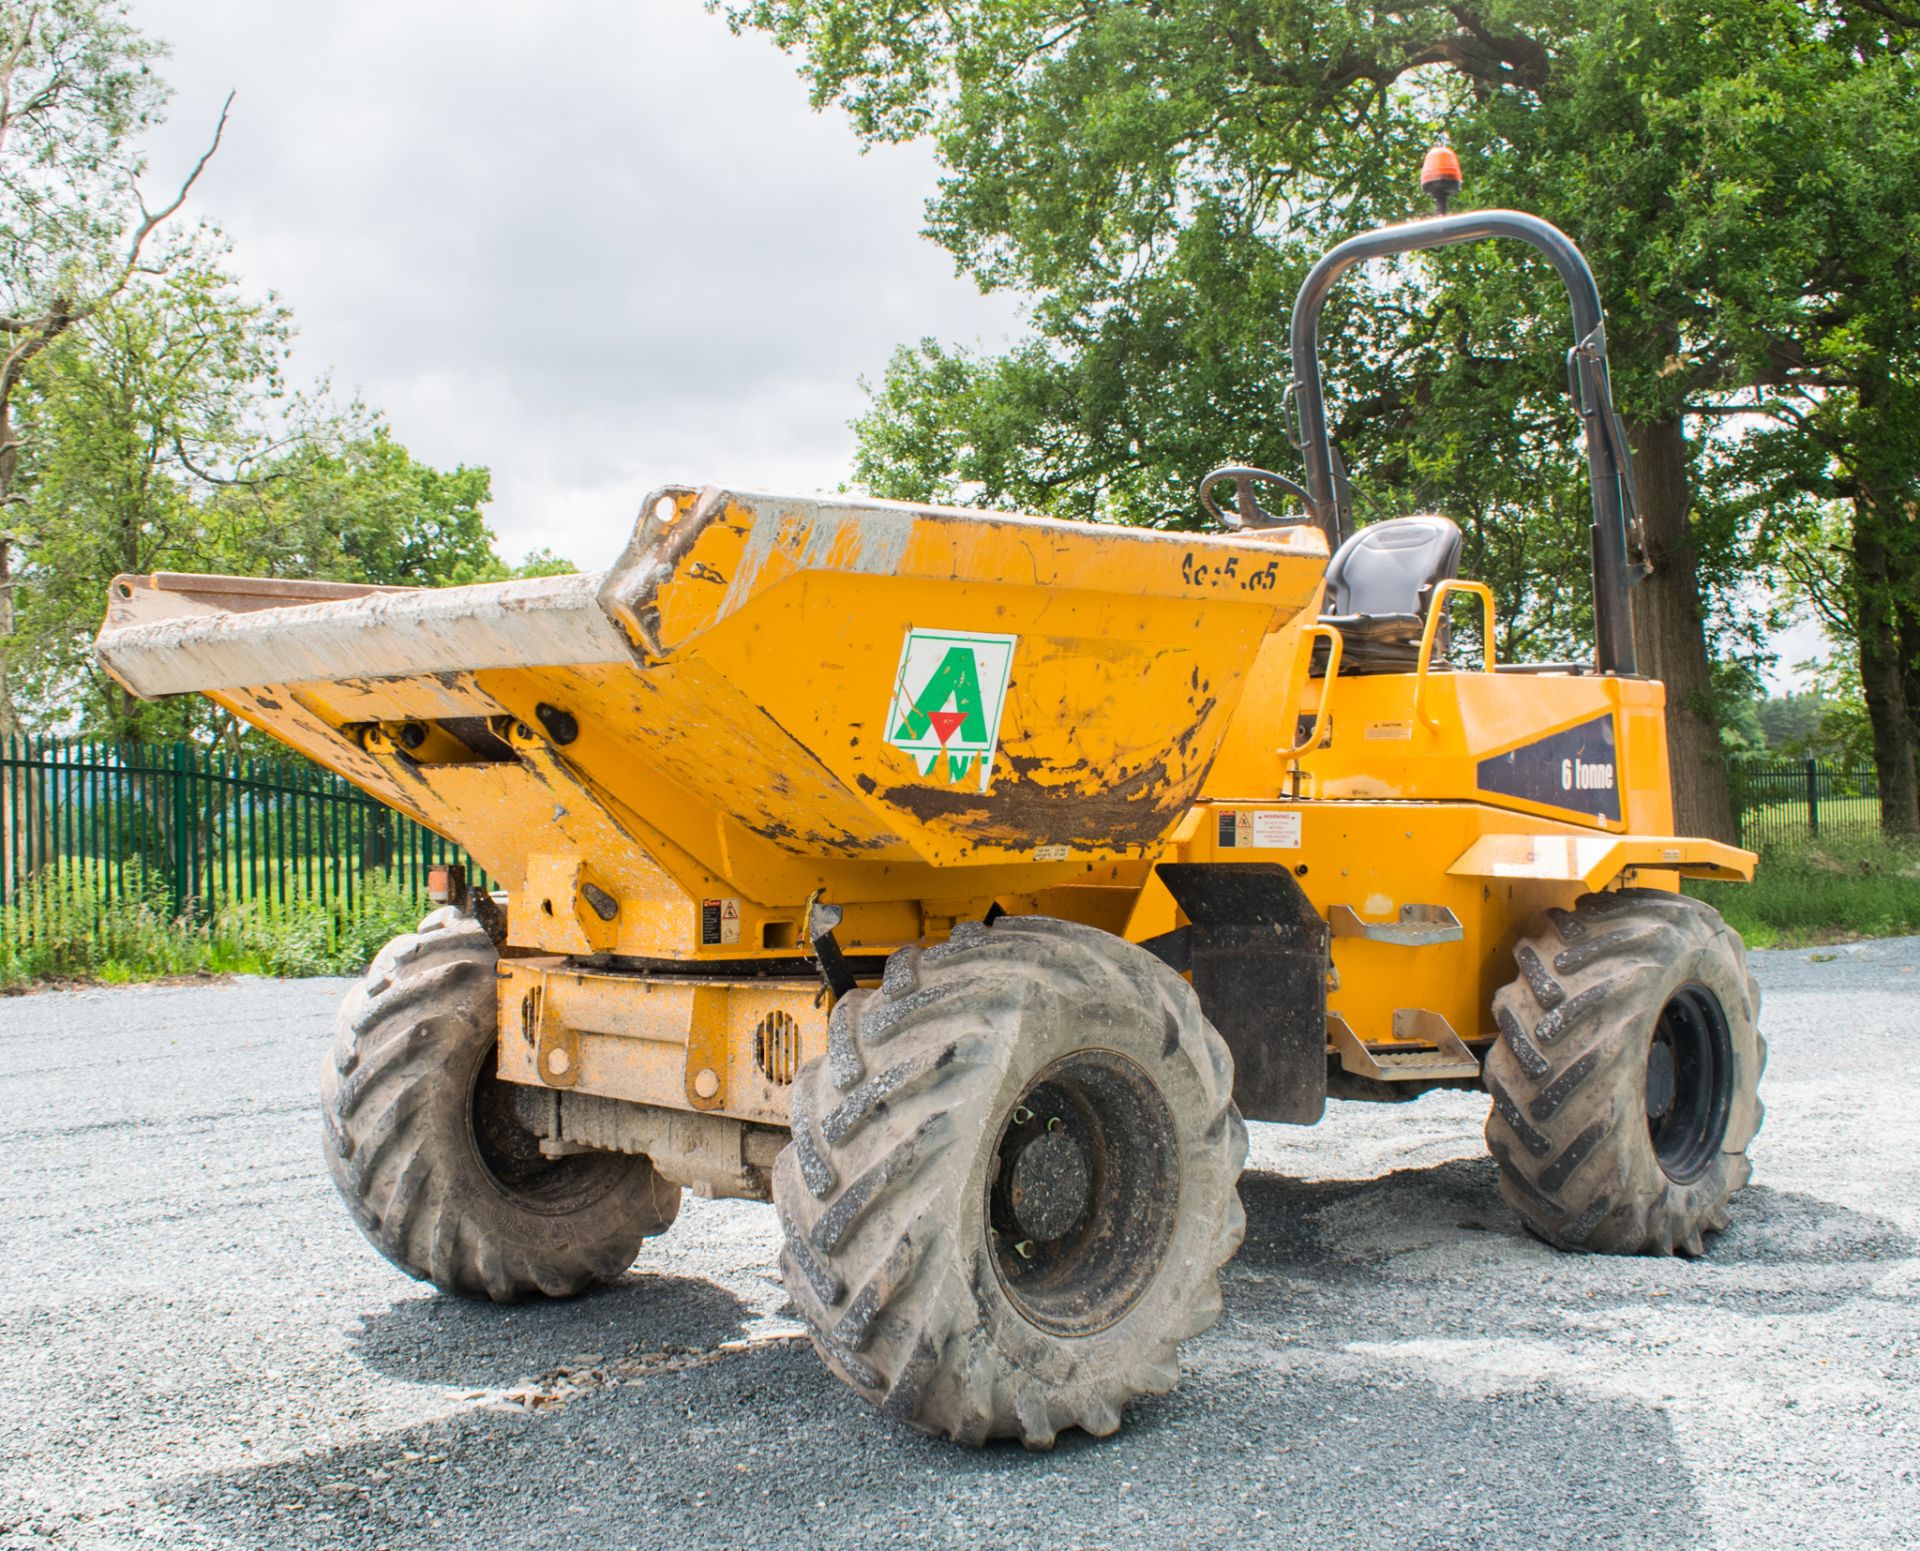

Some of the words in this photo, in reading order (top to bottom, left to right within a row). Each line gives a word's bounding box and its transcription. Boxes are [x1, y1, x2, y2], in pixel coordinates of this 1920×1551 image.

[893, 646, 989, 743] A
[1561, 758, 1573, 791] 6
[1575, 758, 1614, 790] tonne
